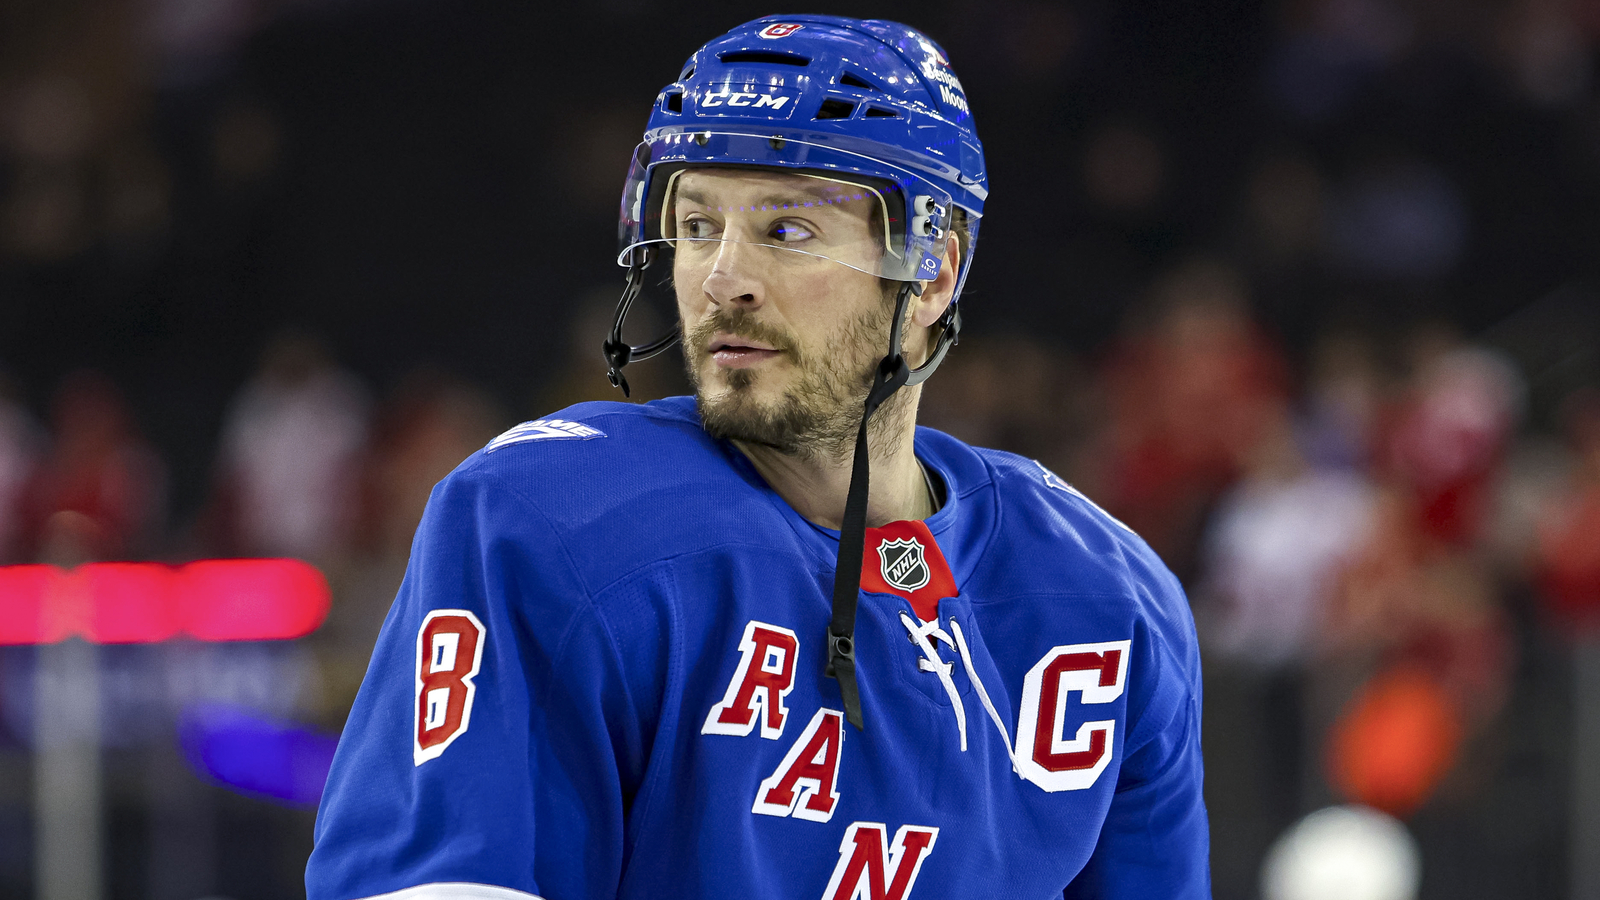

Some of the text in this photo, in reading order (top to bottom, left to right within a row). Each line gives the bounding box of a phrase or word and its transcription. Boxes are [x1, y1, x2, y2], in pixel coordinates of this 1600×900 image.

[759, 23, 804, 39] 8
[701, 89, 790, 110] CCM
[891, 552, 918, 582] NHL
[413, 608, 487, 767] 8
[1012, 639, 1132, 793] C
